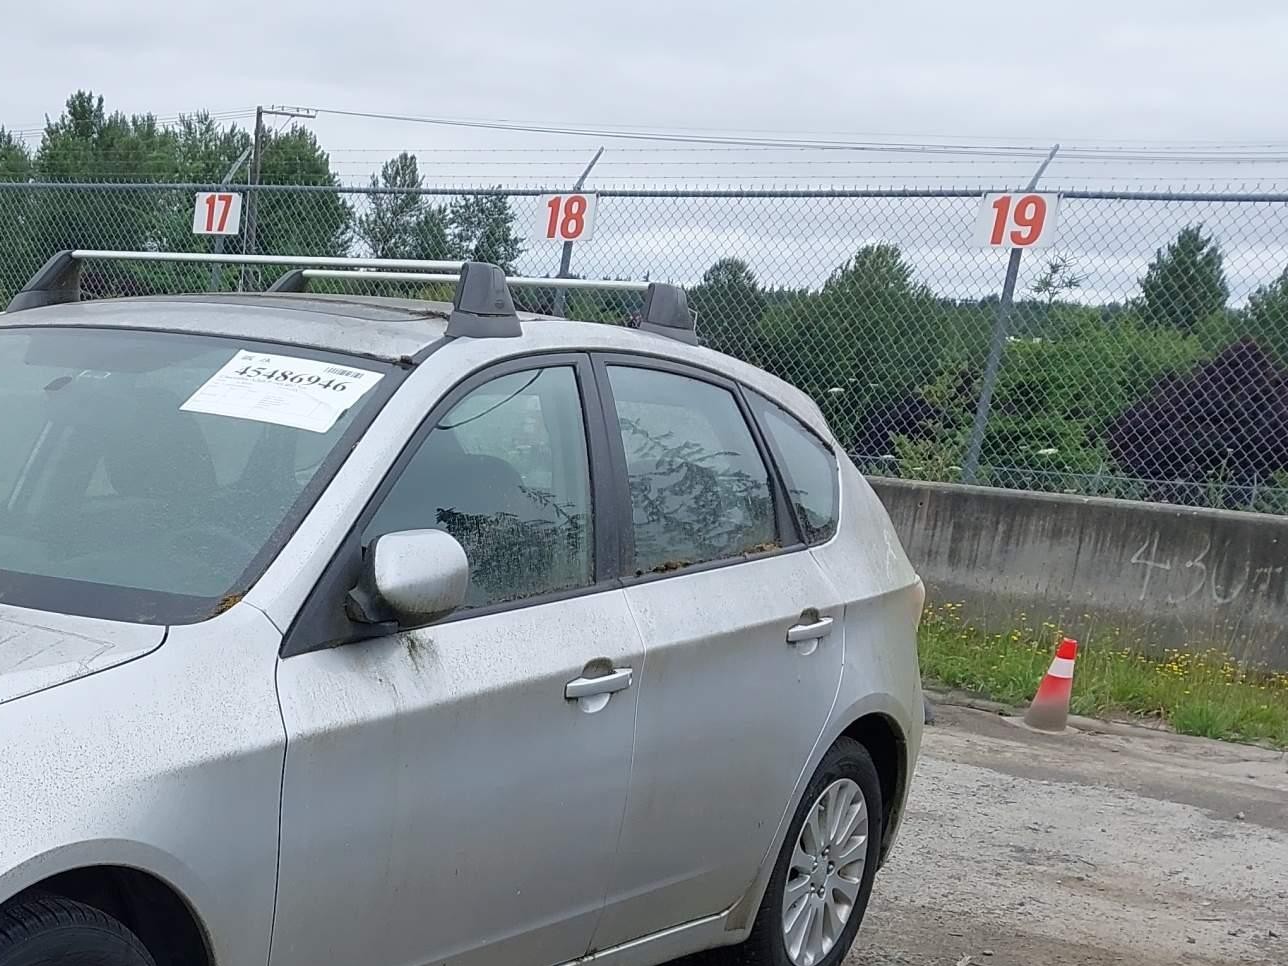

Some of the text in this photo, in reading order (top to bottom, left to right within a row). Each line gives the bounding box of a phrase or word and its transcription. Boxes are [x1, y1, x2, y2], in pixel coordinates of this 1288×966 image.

[205, 192, 233, 234] 17
[546, 194, 588, 240] 18
[989, 194, 1048, 247] 19
[235, 365, 353, 392] 45486946
